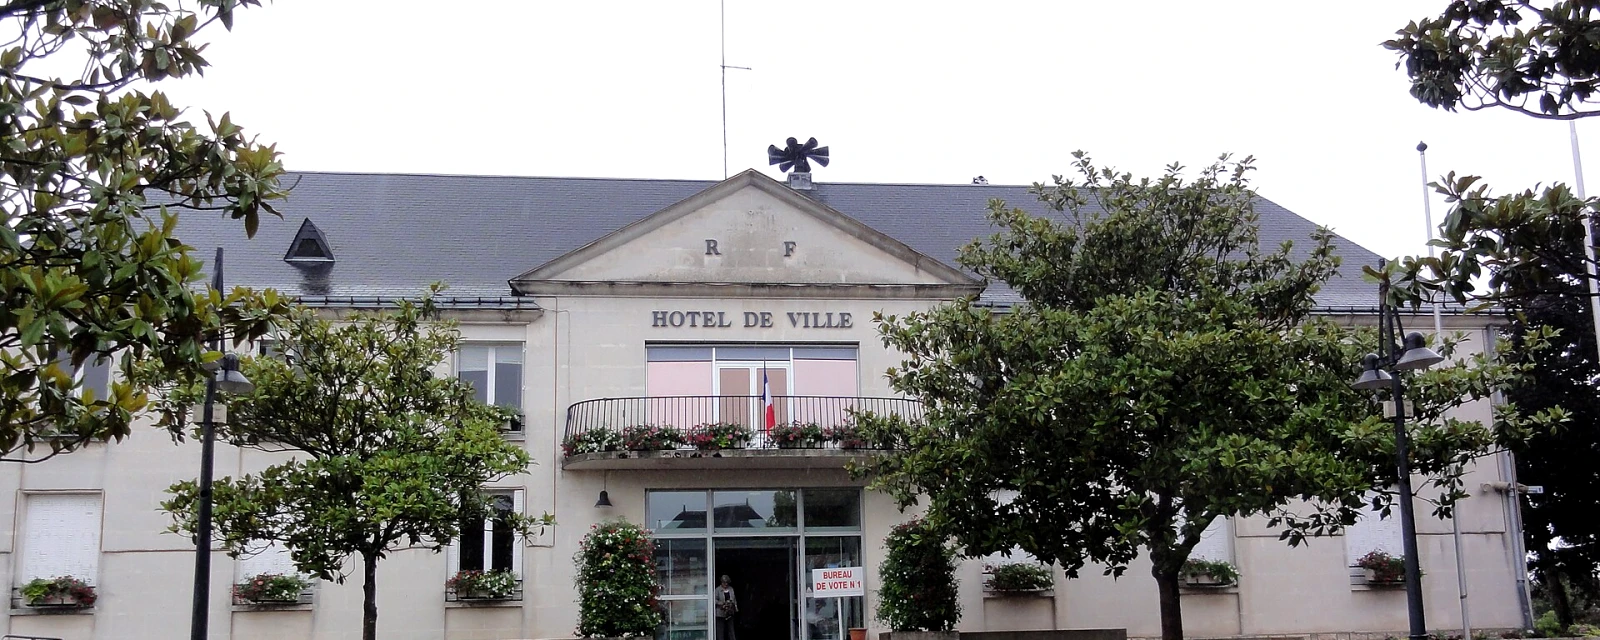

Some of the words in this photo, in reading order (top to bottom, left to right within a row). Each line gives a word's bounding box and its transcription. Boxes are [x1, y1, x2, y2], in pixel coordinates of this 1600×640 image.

[705, 239, 721, 255] R
[784, 241, 797, 257] F
[651, 311, 732, 328] HOTEL
[743, 311, 774, 328] DE
[786, 312, 854, 329] VILLE
[823, 570, 852, 579] BUREAU
[816, 582, 826, 590] DE
[828, 581, 848, 590] VOTE
